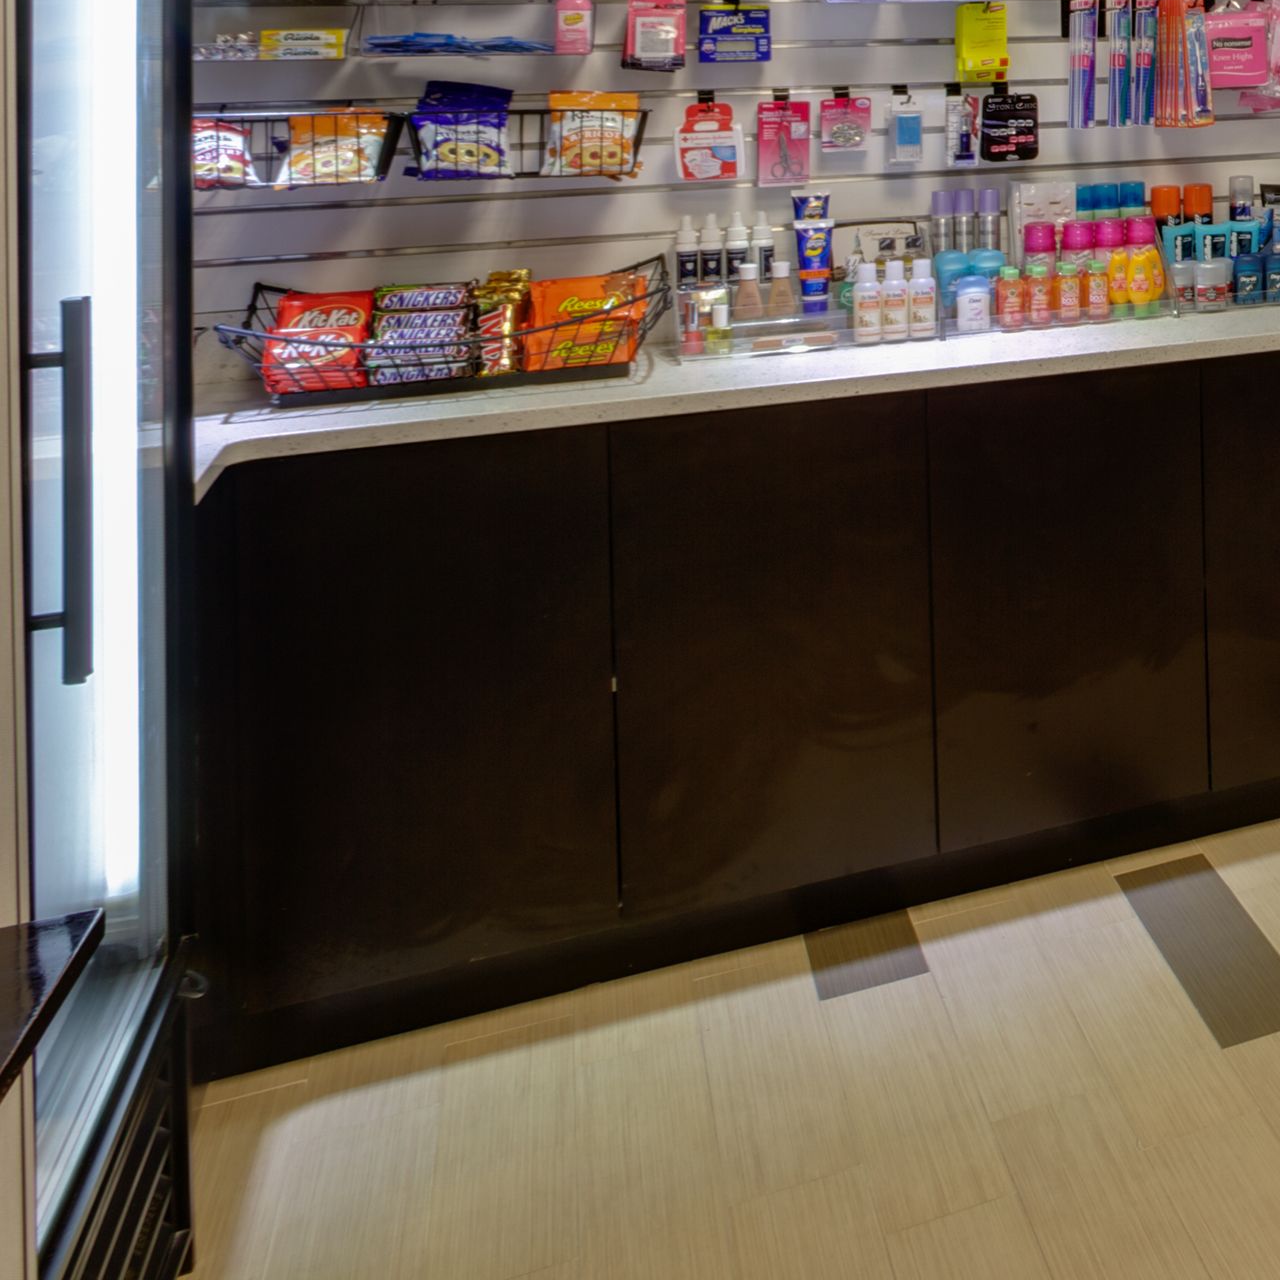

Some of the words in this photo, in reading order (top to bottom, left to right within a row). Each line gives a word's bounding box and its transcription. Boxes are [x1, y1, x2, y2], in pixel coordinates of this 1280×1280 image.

[383, 288, 464, 309] SNICKERS
[558, 296, 620, 312] Reese's
[379, 311, 463, 330] SNICKERS
